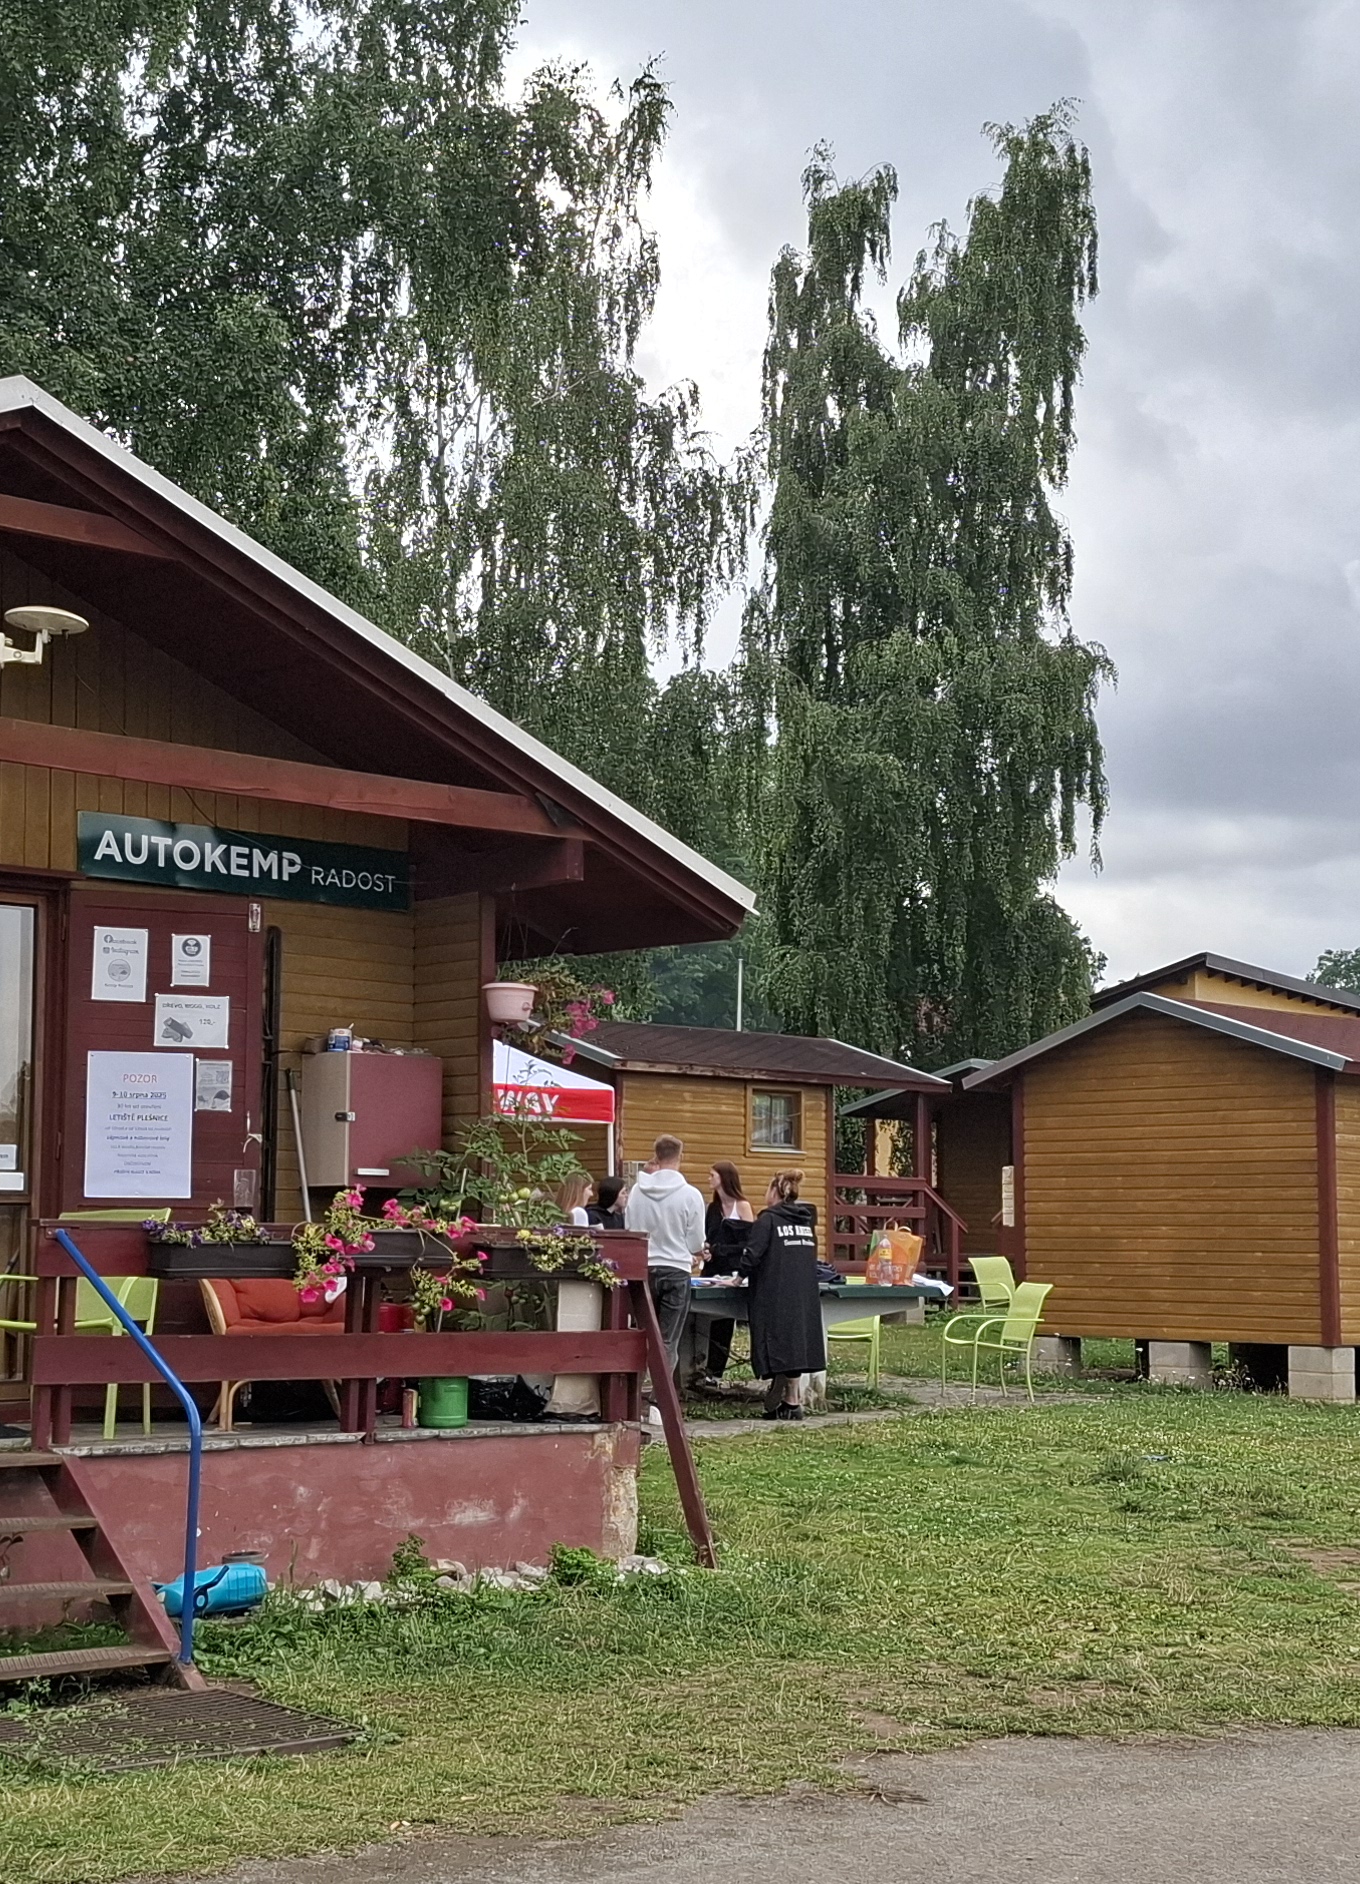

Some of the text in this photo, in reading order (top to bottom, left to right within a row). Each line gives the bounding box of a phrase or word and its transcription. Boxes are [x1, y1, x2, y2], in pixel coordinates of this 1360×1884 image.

[93, 830, 396, 893] AUTOKEMP RADOST
[123, 1074, 158, 1084] POZOR
[777, 1225, 795, 1237] LOS
